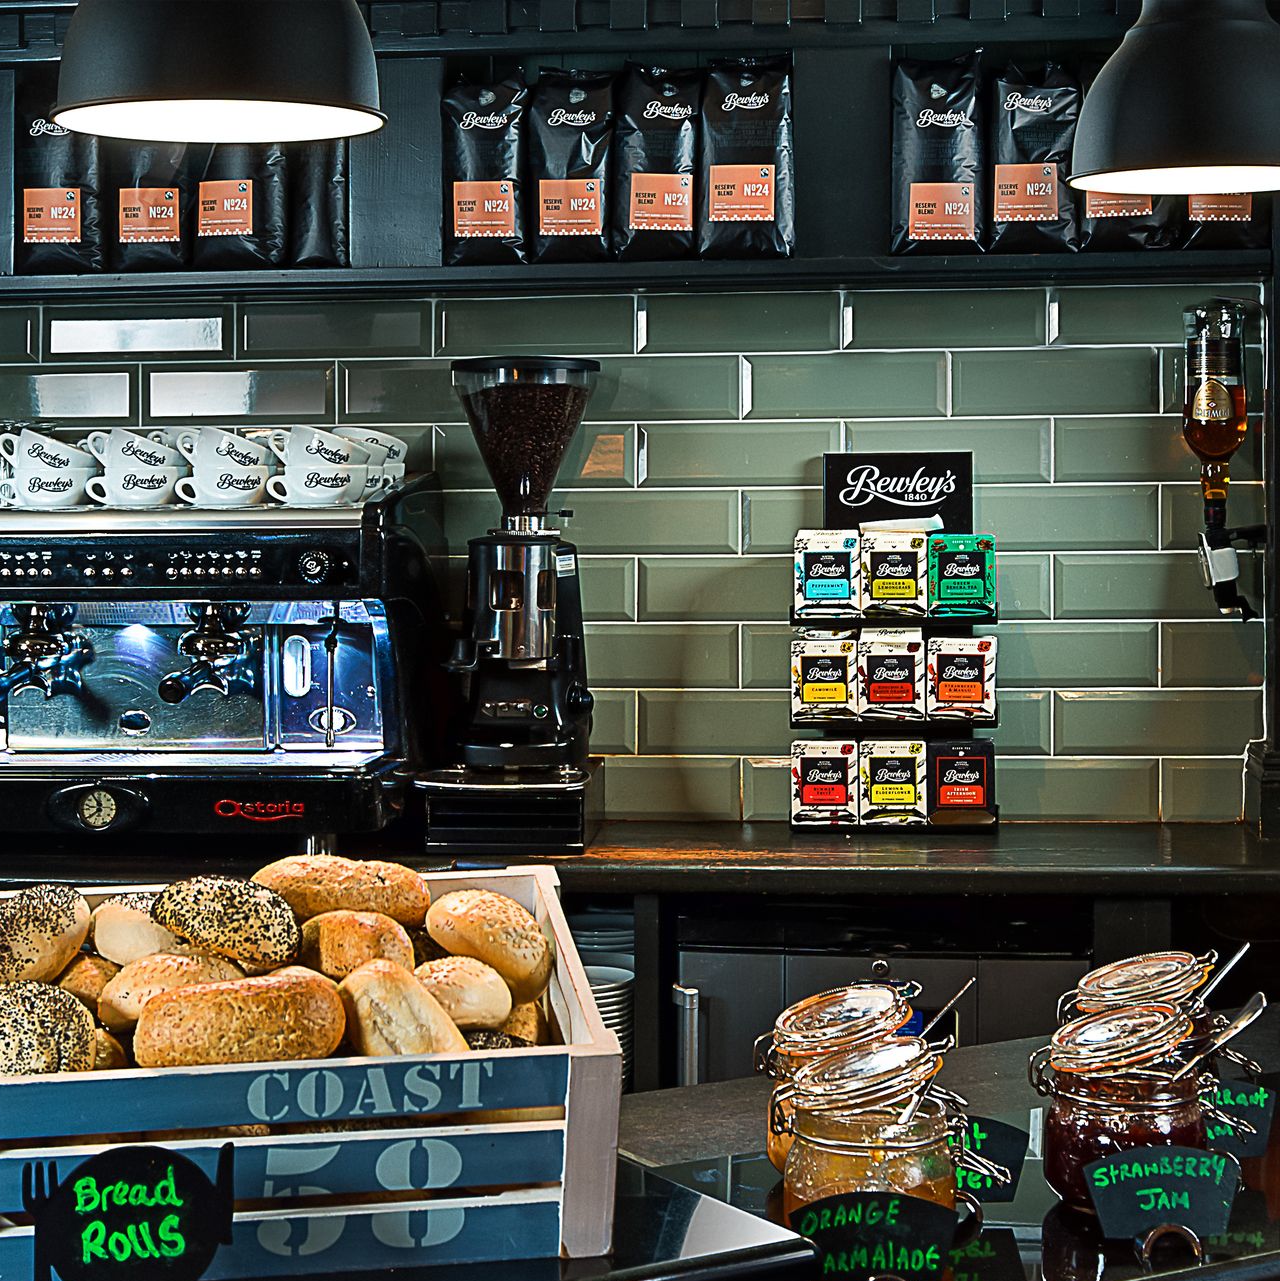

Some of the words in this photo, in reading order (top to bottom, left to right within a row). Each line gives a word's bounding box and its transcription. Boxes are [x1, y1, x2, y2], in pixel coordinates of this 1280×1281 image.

[642, 100, 692, 119] Bewley's
[721, 92, 770, 111] Bewley's
[1003, 91, 1052, 112] Bewley's
[459, 111, 508, 130] Bewley's
[547, 108, 596, 127] Bewley's
[916, 108, 966, 128] Bewley's
[27, 443, 71, 468] Bewley's
[122, 440, 166, 467] Bewley's
[216, 441, 260, 466] Bewley's
[305, 439, 350, 465] Bewley's
[28, 477, 73, 493] Bewley's
[122, 473, 168, 491] Bewley's
[216, 473, 262, 491] Bewley's
[304, 472, 351, 489] Bewley's
[839, 465, 957, 507] Bewley's
[904, 492, 928, 502] 1840
[247, 1061, 495, 1121] COAST
[73, 1165, 184, 1213] Bread
[257, 1139, 466, 1257] 58
[1136, 1187, 1191, 1212] JAM
[800, 1200, 901, 1237] ORANGE
